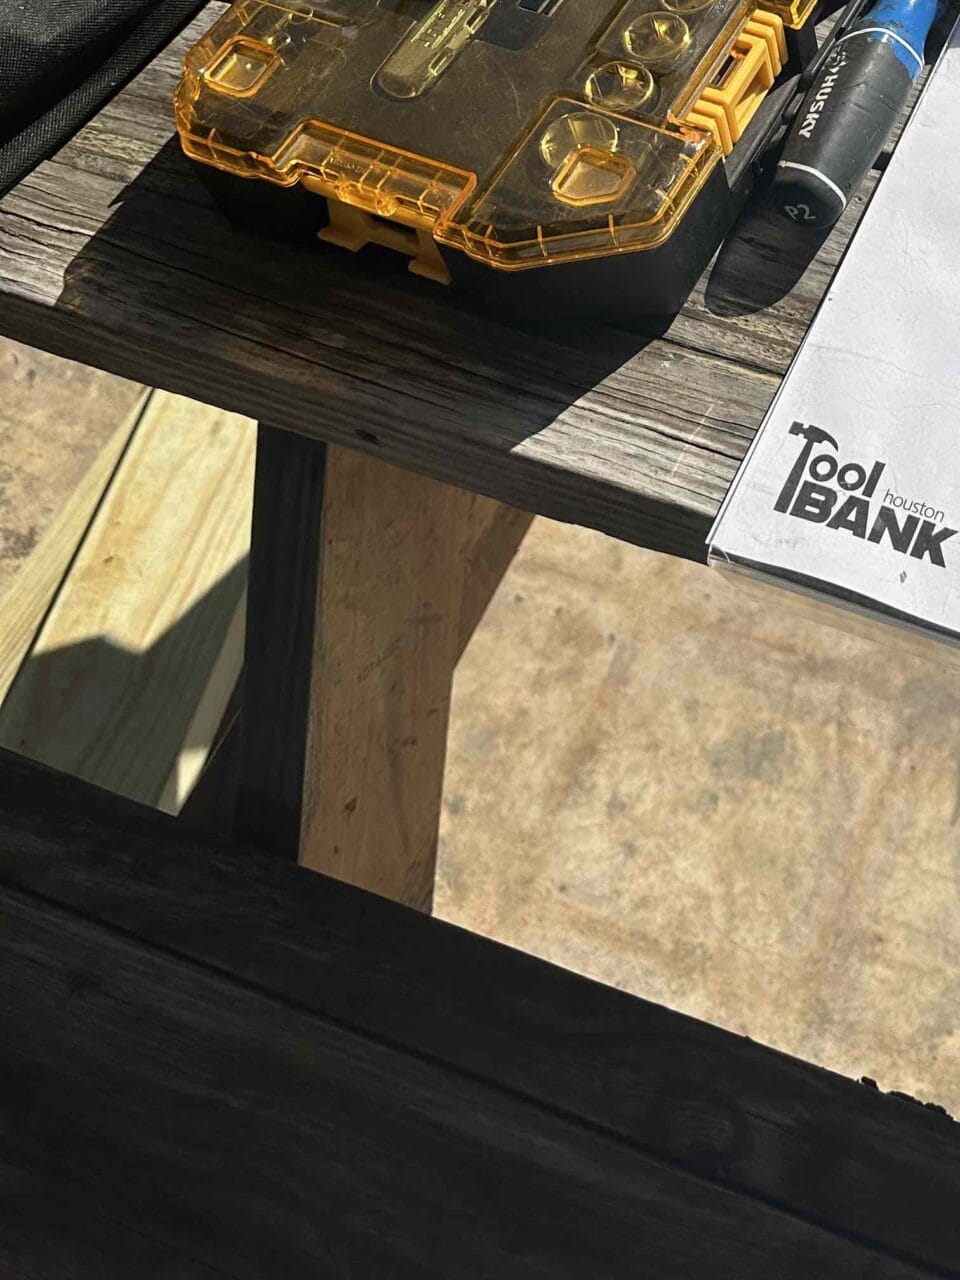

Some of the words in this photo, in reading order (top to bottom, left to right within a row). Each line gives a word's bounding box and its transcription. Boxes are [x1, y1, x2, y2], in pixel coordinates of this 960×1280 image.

[798, 73, 839, 139] HUSKY
[784, 204, 816, 220] P2
[773, 420, 887, 514] Tool
[789, 479, 959, 568] BANK
[882, 488, 945, 522] houston
